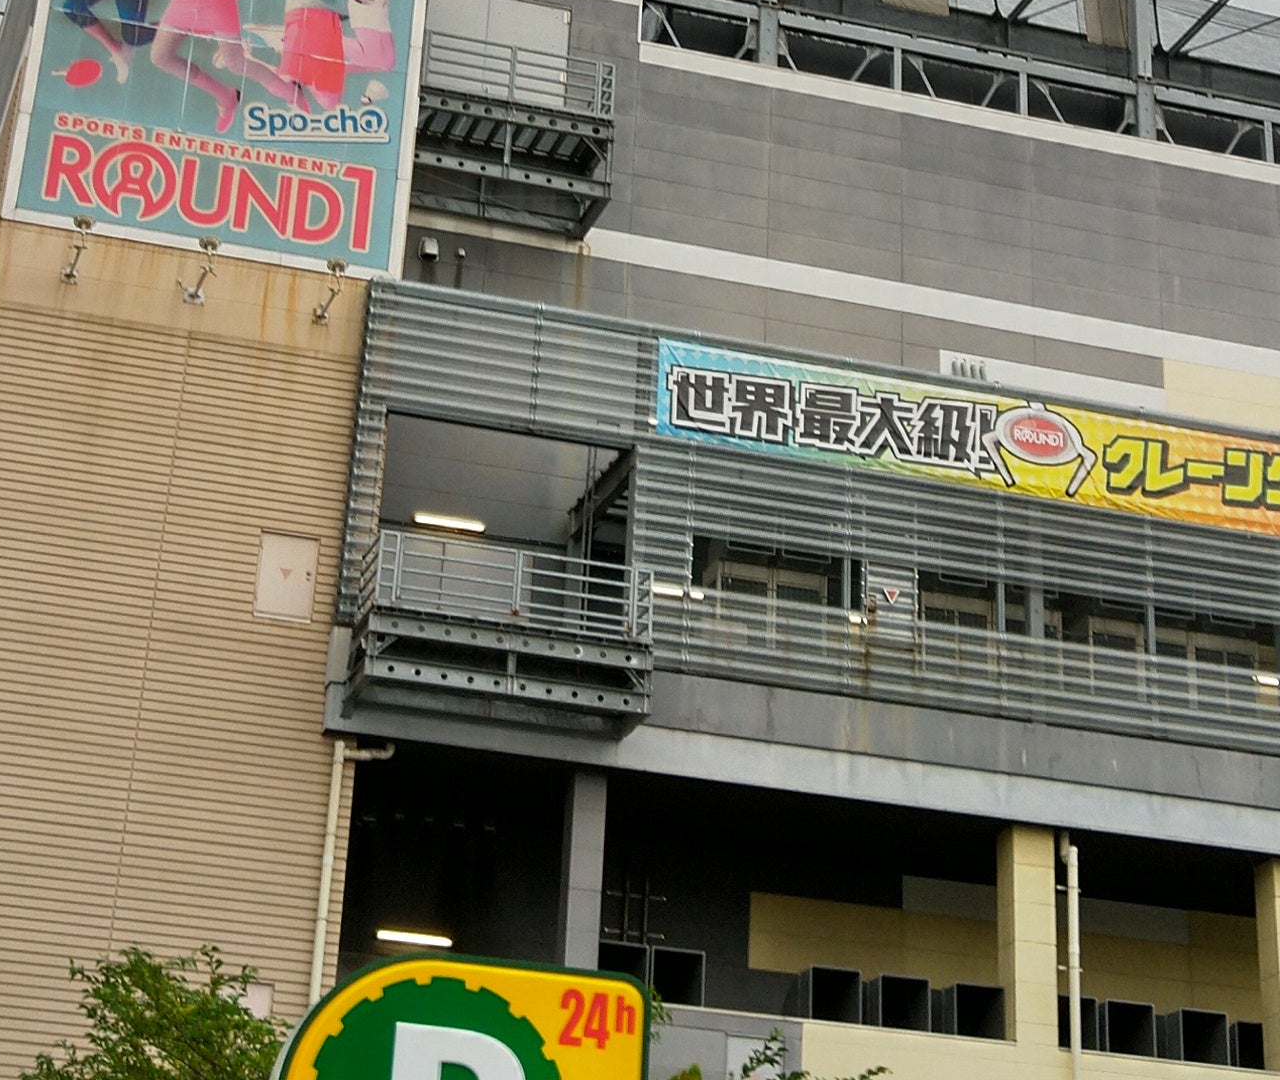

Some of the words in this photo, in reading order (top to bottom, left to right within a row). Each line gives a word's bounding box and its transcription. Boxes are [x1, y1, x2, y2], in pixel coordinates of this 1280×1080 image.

[56, 113, 144, 141] SPORTS
[153, 131, 339, 176] ENTERTAINMENT
[43, 134, 376, 252] ROUND1
[1013, 427, 1064, 448] ROUND1
[558, 987, 636, 1050] 24h
